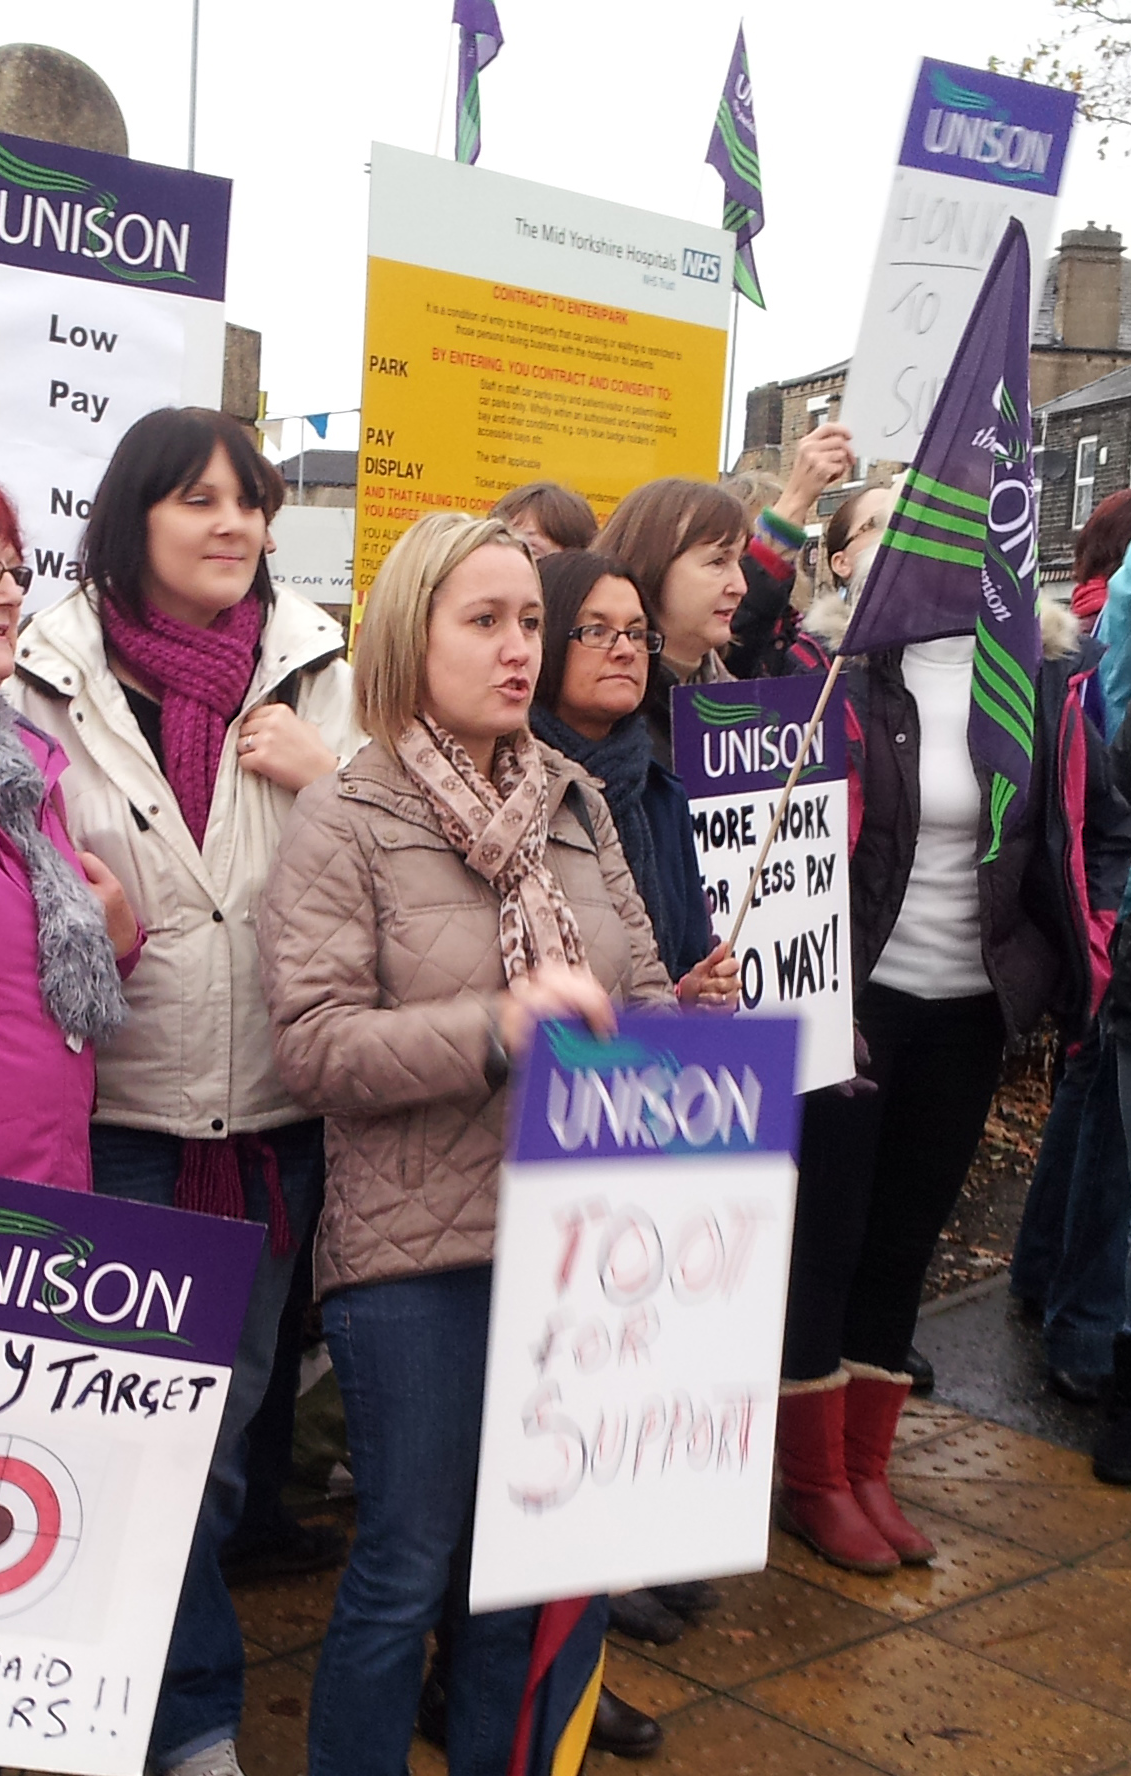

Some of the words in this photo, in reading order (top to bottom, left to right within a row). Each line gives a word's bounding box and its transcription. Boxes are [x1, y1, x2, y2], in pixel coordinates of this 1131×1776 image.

[923, 108, 1054, 173] UNISON
[515, 216, 538, 239] The
[542, 222, 565, 245] Mid
[568, 227, 623, 256] Yorkshire
[626, 239, 676, 270] Hospitals
[683, 250, 720, 282] NHS
[493, 285, 548, 310] CONTRACT
[549, 296, 566, 313] TO
[49, 313, 118, 353] Low
[369, 355, 408, 376] PARK
[432, 346, 447, 362] BY
[508, 360, 530, 377] YOU
[48, 380, 110, 423] Pay
[365, 427, 395, 447] PAY
[364, 457, 423, 480] DISPLAY
[363, 484, 385, 499] AND
[388, 487, 413, 503] THAT
[455, 495, 467, 509] TO
[363, 503, 384, 517] YOU
[34, 549, 81, 581] Wa
[291, 575, 323, 585] CAR
[703, 720, 825, 779] UNISON
[691, 804, 756, 853] MORE
[768, 795, 831, 844] WORK
[805, 853, 837, 898] PAY
[773, 913, 839, 1002] WAY!
[546, 1063, 765, 1149] UNISON
[552, 1197, 774, 1307] TOOT
[46, 1353, 217, 1419] TARGET
[507, 1380, 769, 1514] SUPPORT
